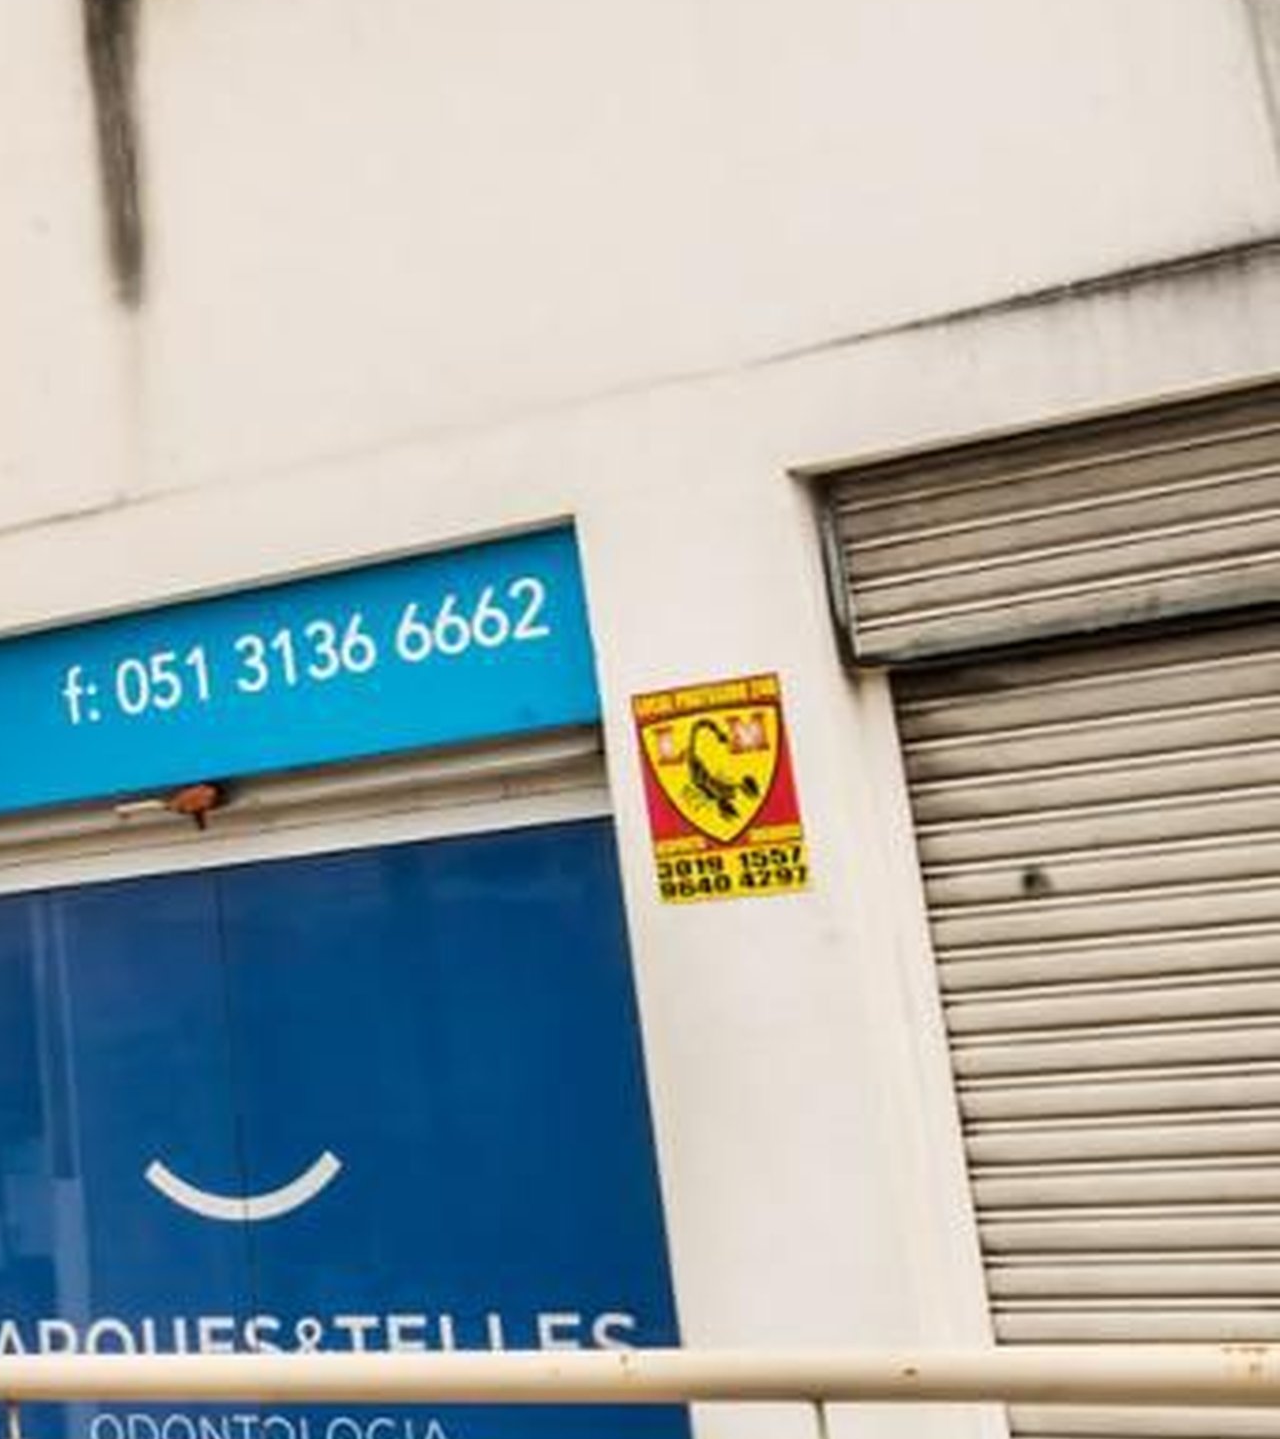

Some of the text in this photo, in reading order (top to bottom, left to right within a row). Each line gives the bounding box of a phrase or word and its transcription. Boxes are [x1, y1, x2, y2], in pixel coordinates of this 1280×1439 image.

[62, 578, 550, 725] f: 051 3136 6662
